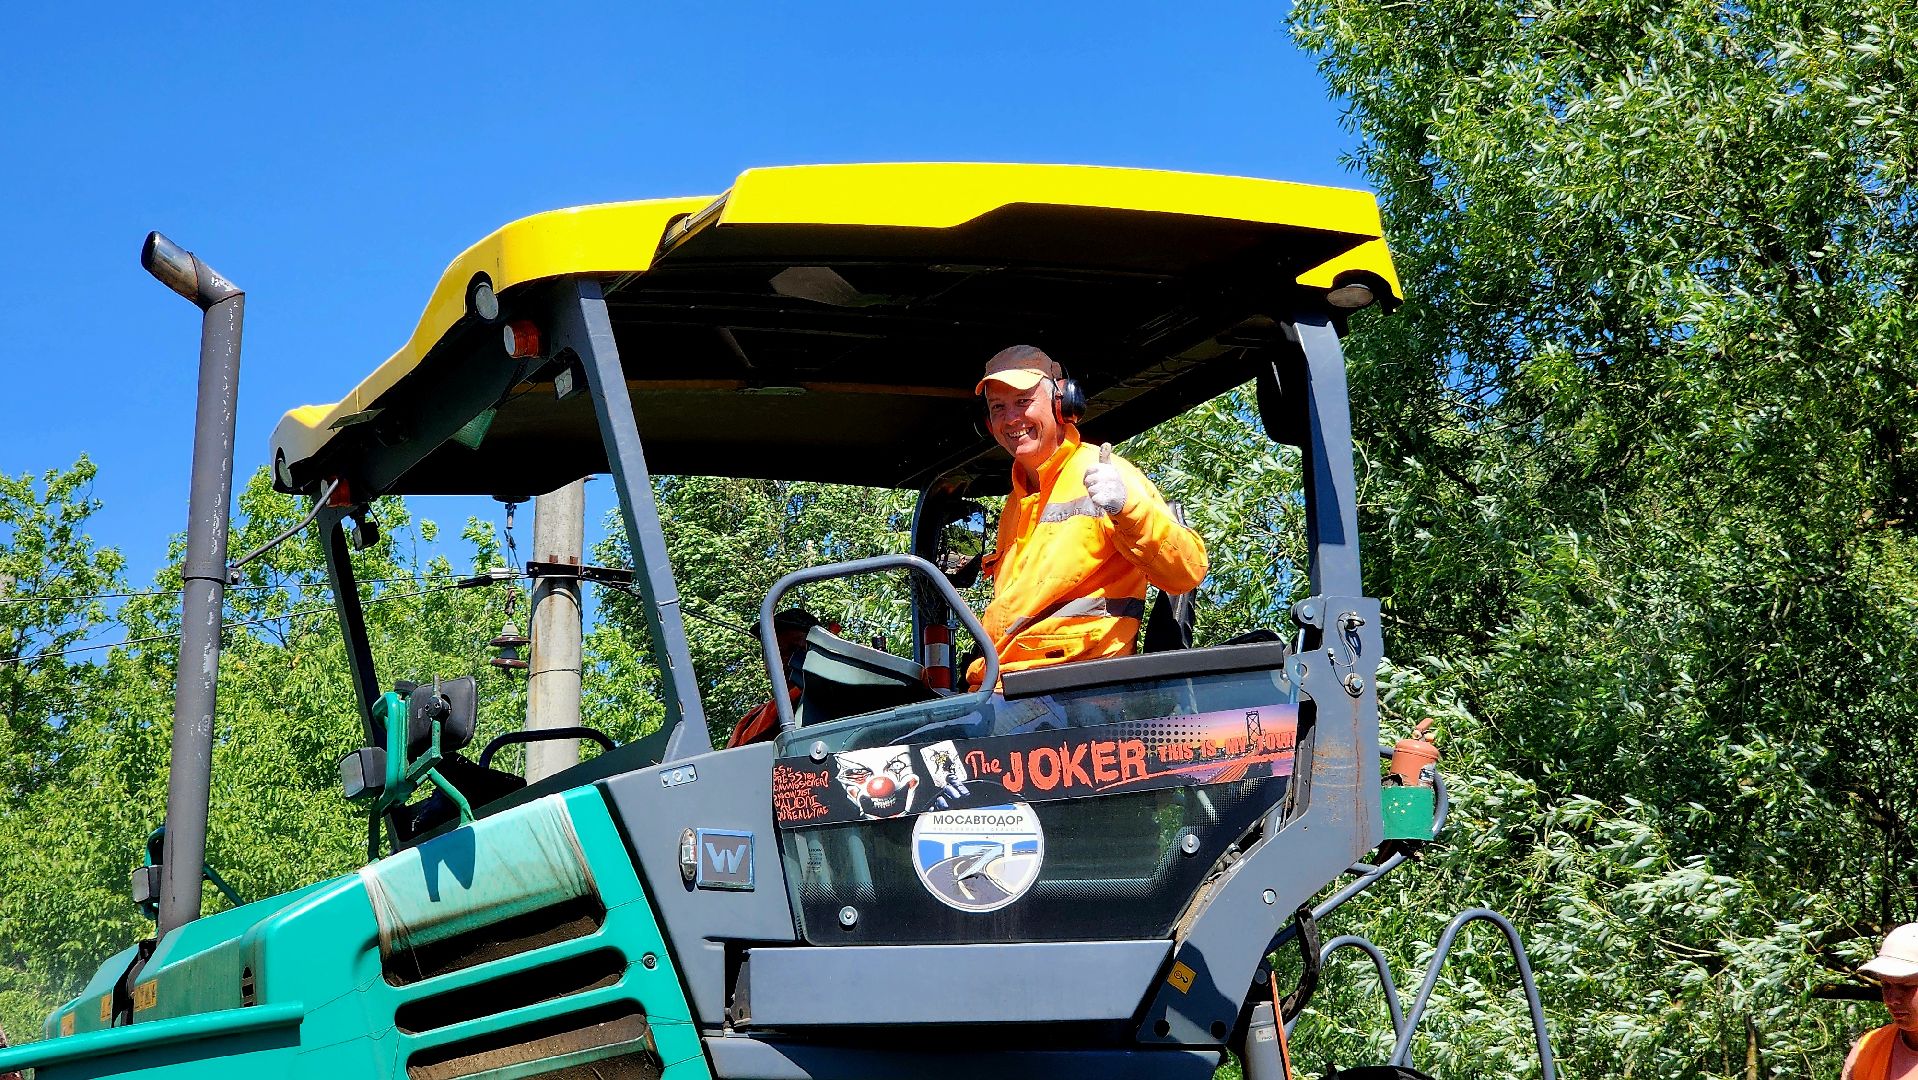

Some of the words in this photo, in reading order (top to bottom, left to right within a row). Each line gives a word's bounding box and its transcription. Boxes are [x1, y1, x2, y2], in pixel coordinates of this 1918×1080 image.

[1157, 741, 1194, 762] THIS
[1200, 739, 1217, 758] IS
[1225, 735, 1248, 755] MY
[965, 750, 1002, 778] The
[1002, 739, 1148, 793] JOKER
[933, 815, 1024, 827] МОСАВТОДОР
